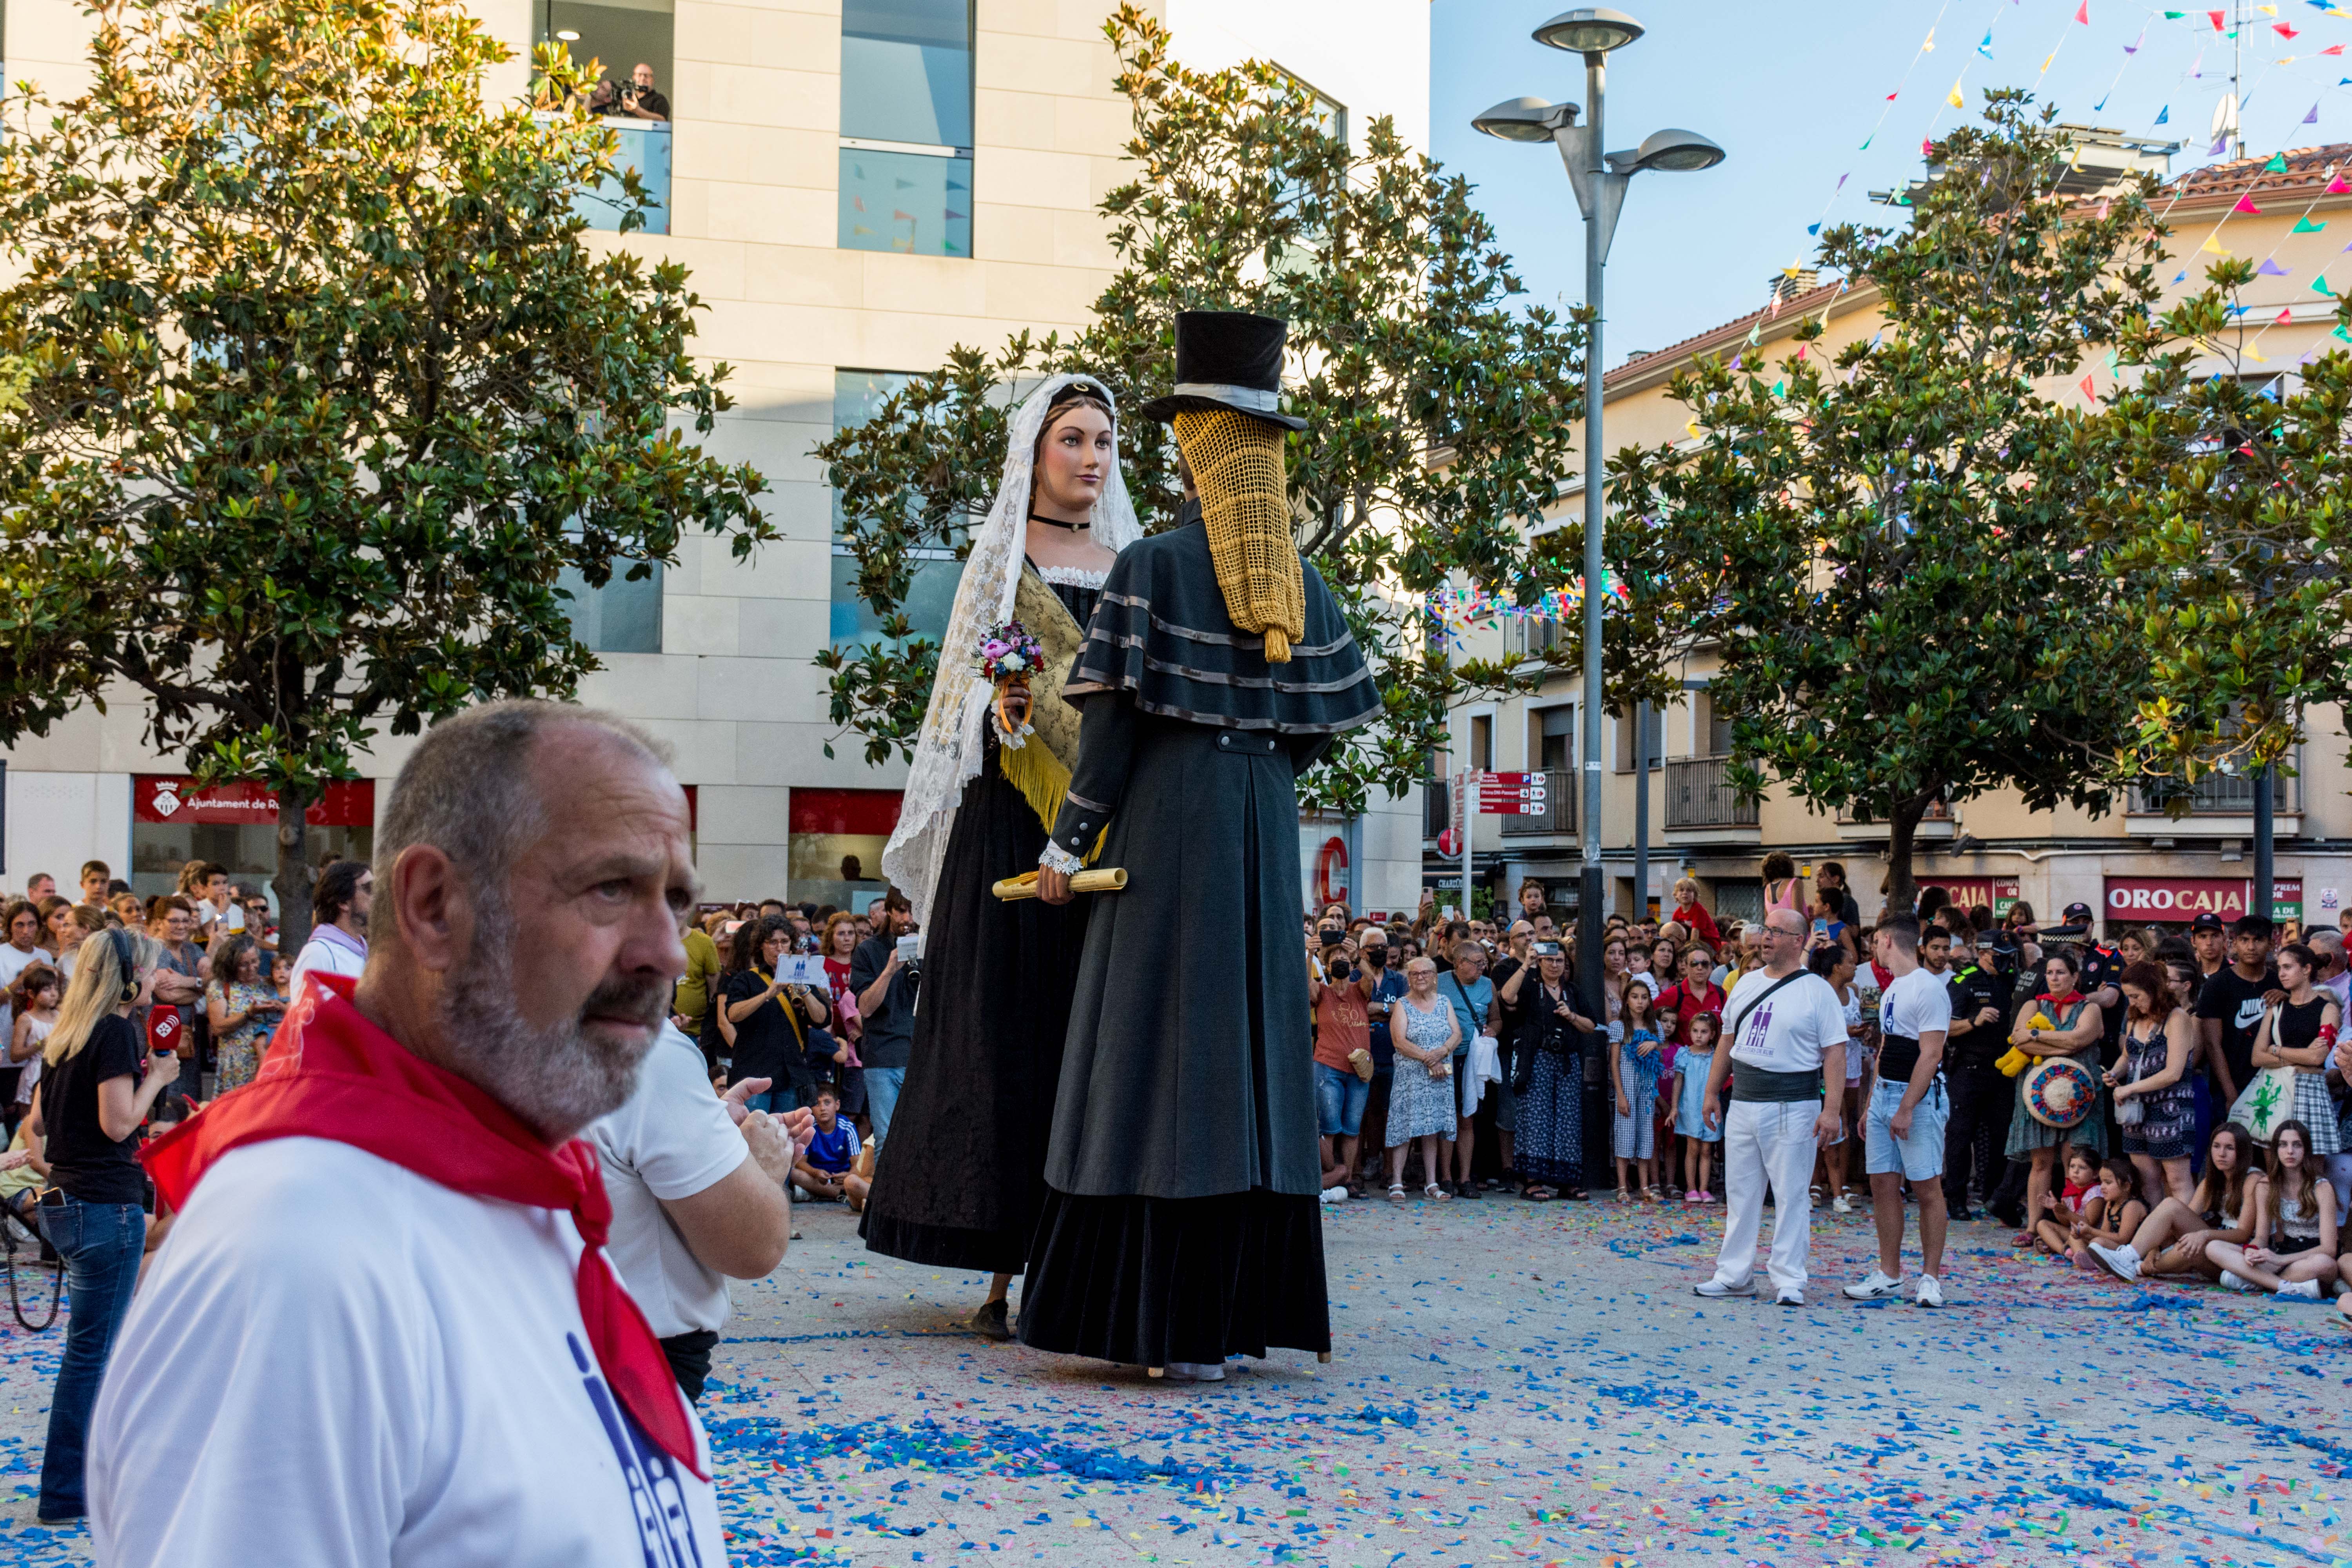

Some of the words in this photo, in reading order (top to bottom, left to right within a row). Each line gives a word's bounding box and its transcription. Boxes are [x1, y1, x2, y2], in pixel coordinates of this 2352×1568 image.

[187, 797, 249, 809] Ajuntament
[252, 798, 266, 809] de
[2109, 888, 2242, 914] OROCAJA
[1384, 993, 1396, 1002] Jo
